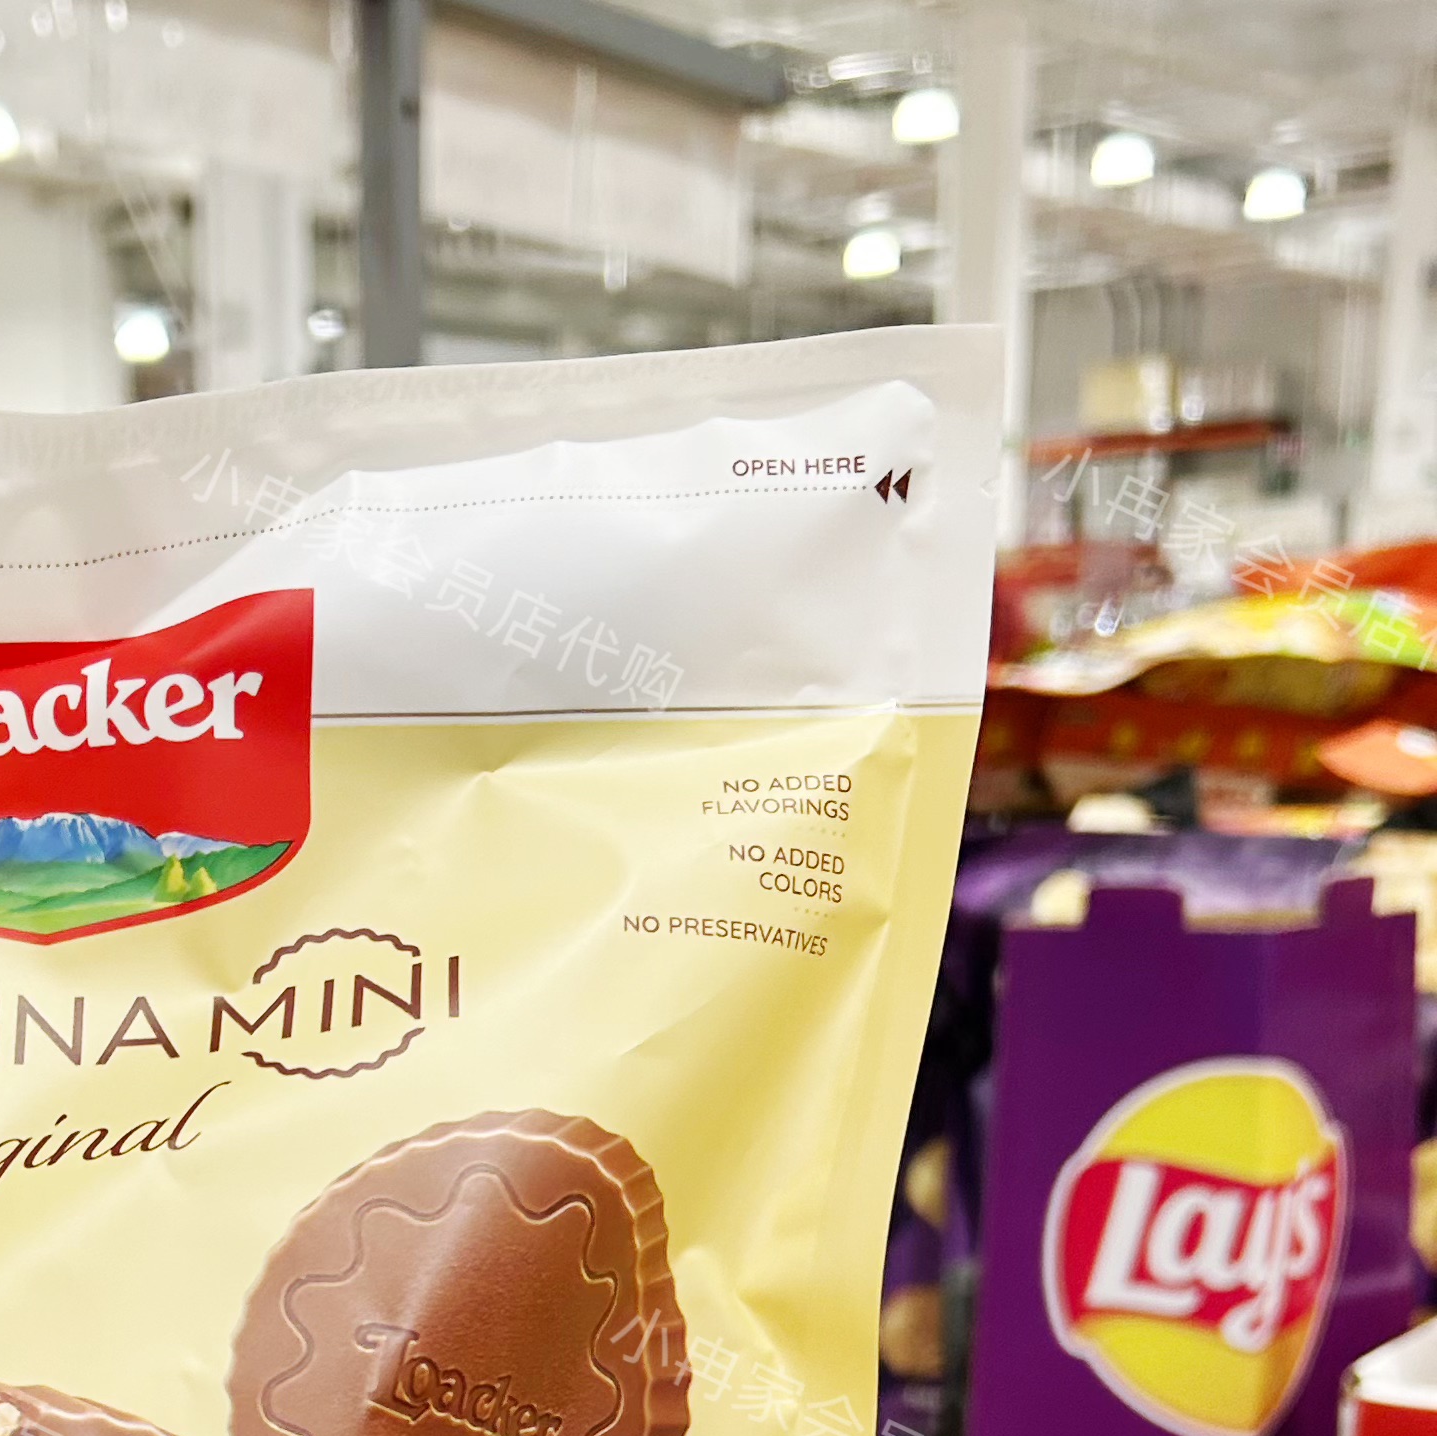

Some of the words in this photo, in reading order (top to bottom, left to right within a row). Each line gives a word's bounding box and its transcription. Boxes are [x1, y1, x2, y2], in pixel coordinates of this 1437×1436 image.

[732, 459, 796, 477] OPEN
[805, 455, 866, 475] HERE
[723, 779, 760, 794] NO
[769, 774, 852, 793] ADDED
[702, 798, 850, 821] FLAVORINGS
[729, 844, 766, 862] NO
[773, 847, 845, 875] ADDED
[759, 871, 843, 904] COLORS
[623, 915, 660, 933] NO
[669, 916, 829, 957] PRESERVATIVES
[209, 955, 461, 1054] MINI
[1082, 1155, 1332, 1356] Lay's
